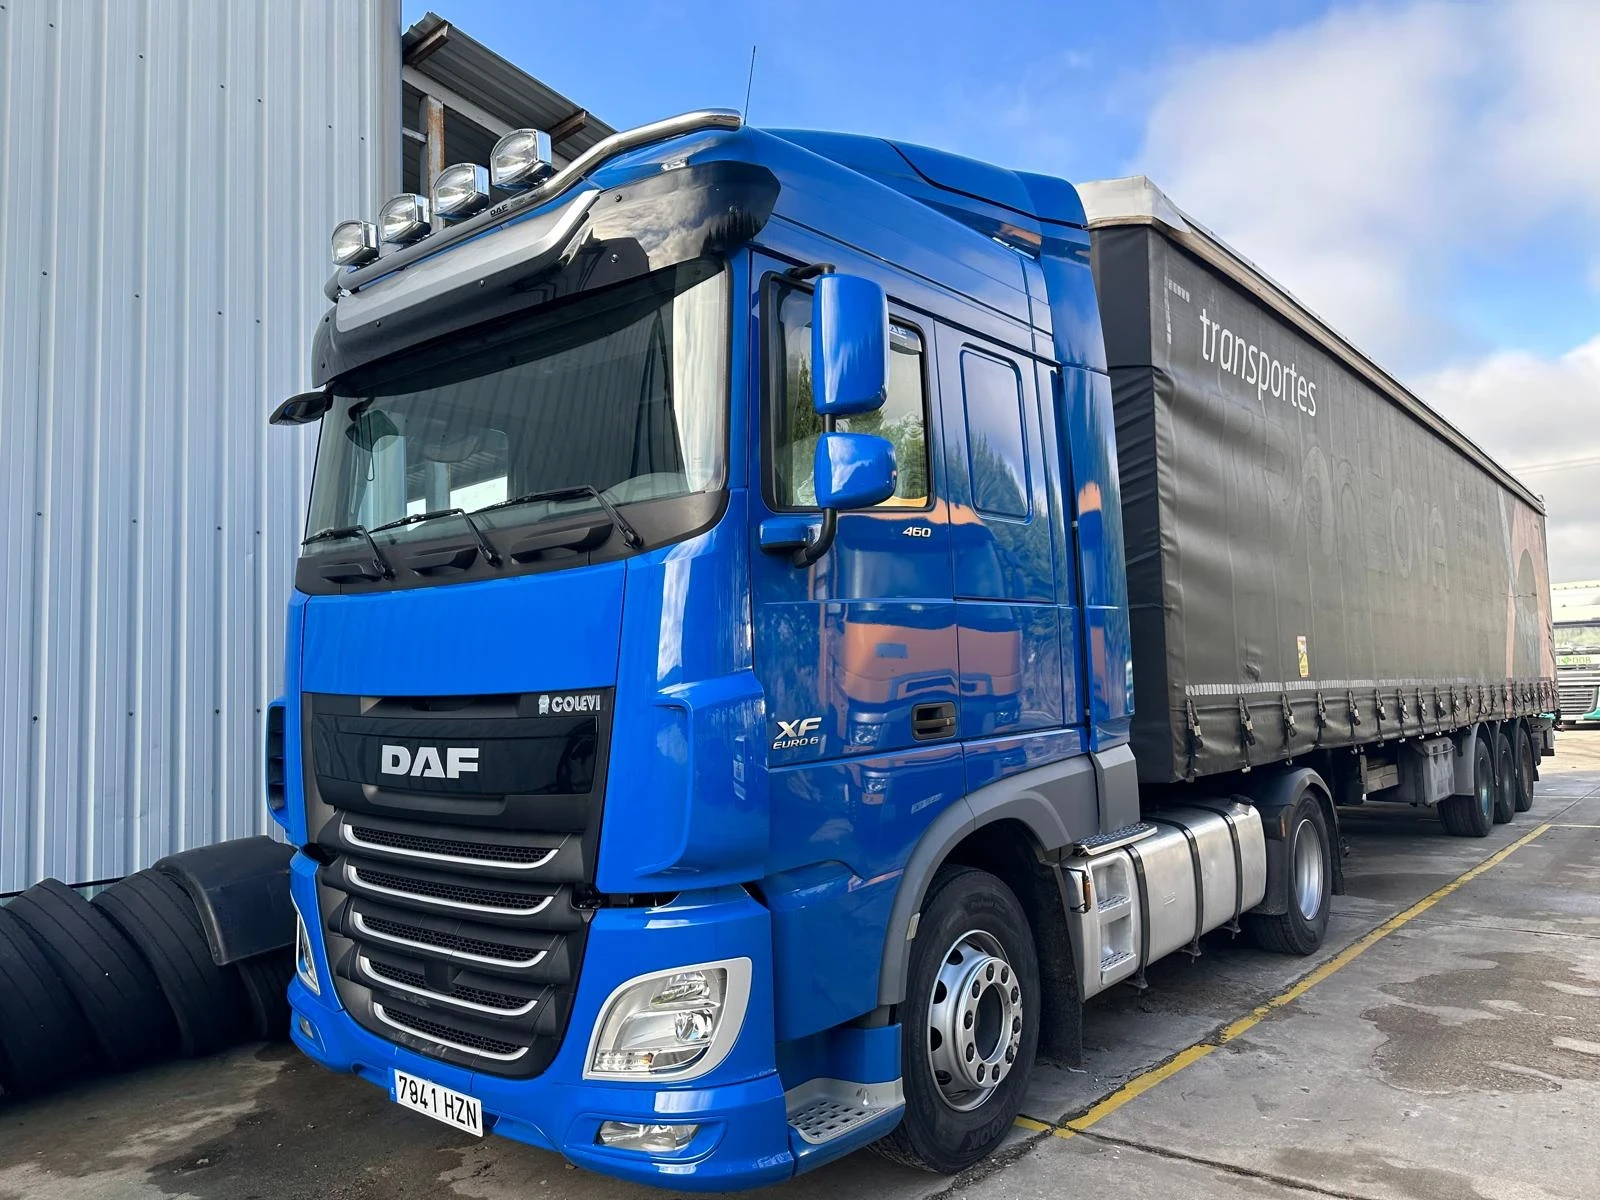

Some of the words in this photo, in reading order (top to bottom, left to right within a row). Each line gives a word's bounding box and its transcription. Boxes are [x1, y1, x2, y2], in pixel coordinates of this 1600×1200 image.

[490, 203, 508, 216] DAF
[889, 323, 907, 336] AF
[1200, 308, 1316, 417] transportes
[902, 526, 932, 538] 460
[551, 694, 601, 713] COLEVI
[774, 716, 822, 740] XF
[772, 738, 809, 750] EURO
[810, 736, 819, 745] 6
[381, 744, 479, 779] DAF
[444, 1091, 477, 1130] HZN
